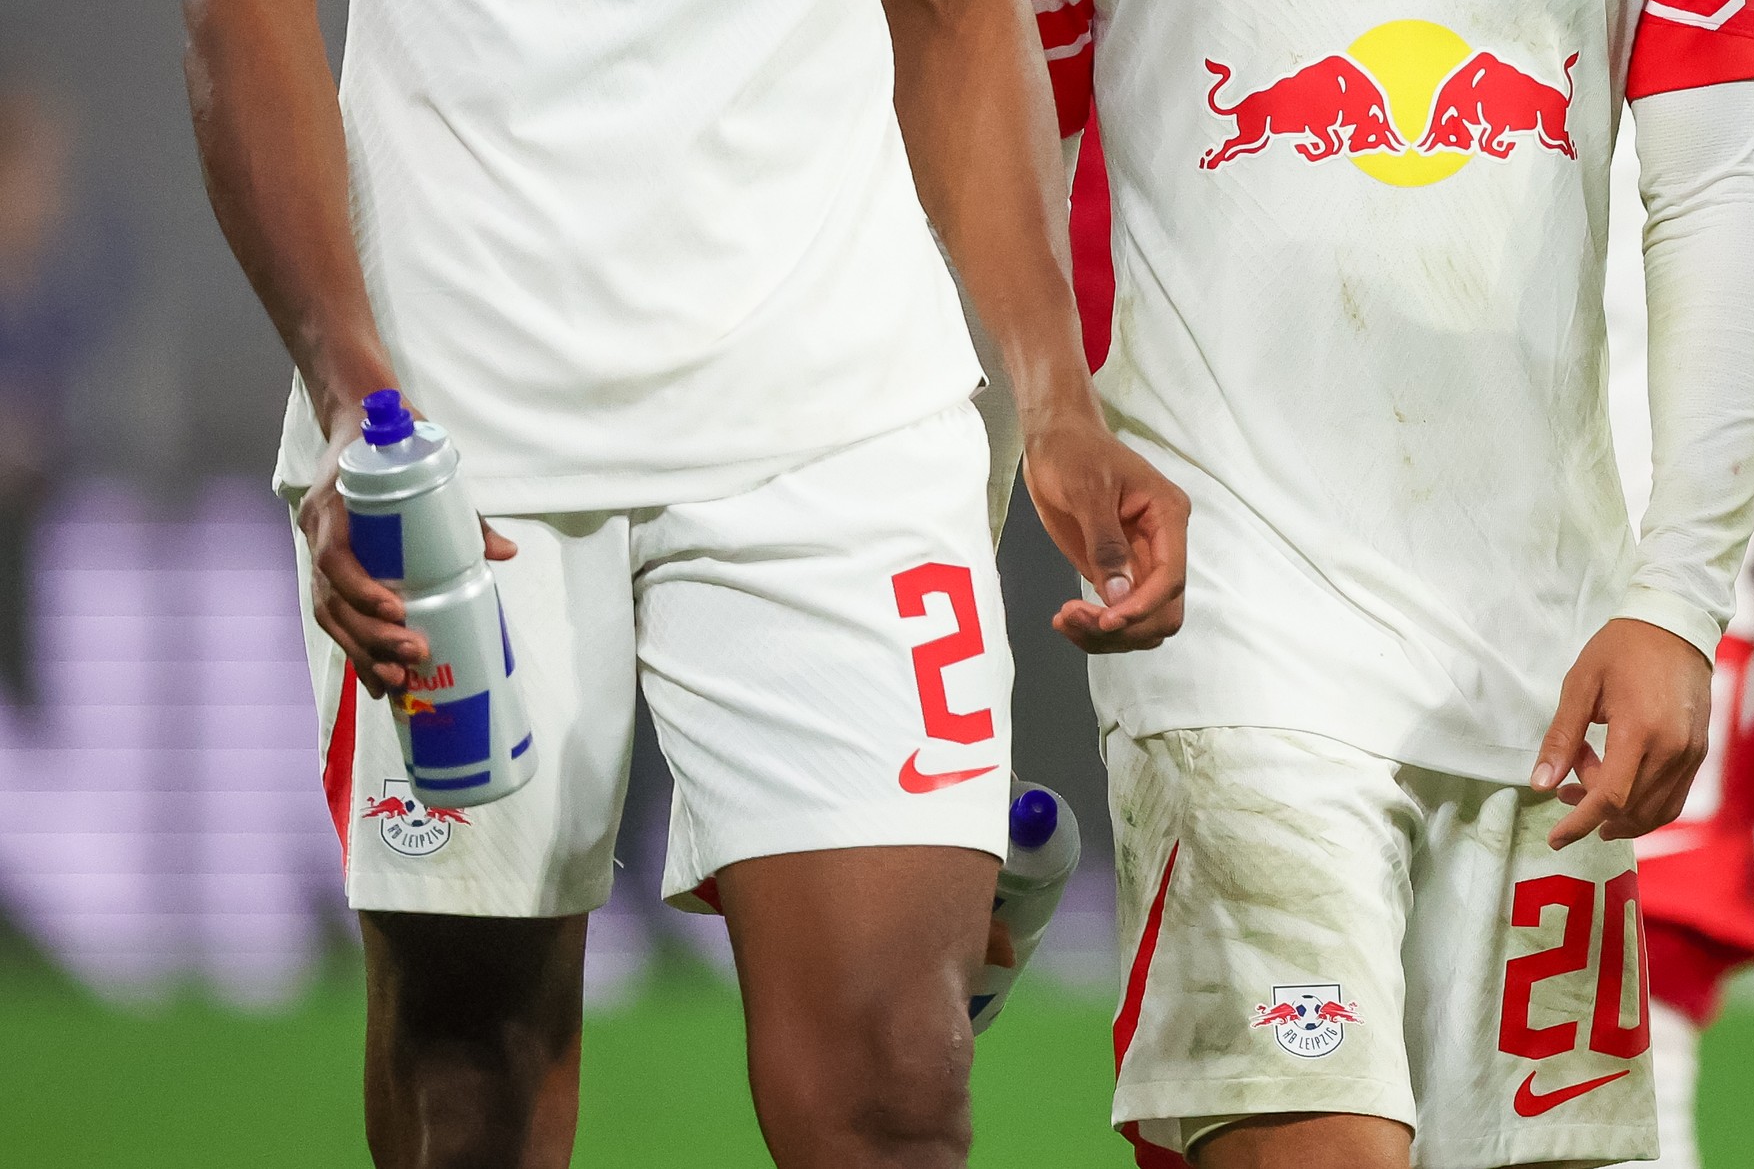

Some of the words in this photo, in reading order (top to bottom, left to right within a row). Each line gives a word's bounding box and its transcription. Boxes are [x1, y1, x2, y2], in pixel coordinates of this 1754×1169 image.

[891, 562, 995, 745] 2
[407, 663, 455, 691] Bull
[402, 826, 444, 848] LEIPZIG
[1498, 868, 1650, 1060] 20
[1282, 1029, 1298, 1044] RB
[1299, 1027, 1338, 1050] LEIPZIG
